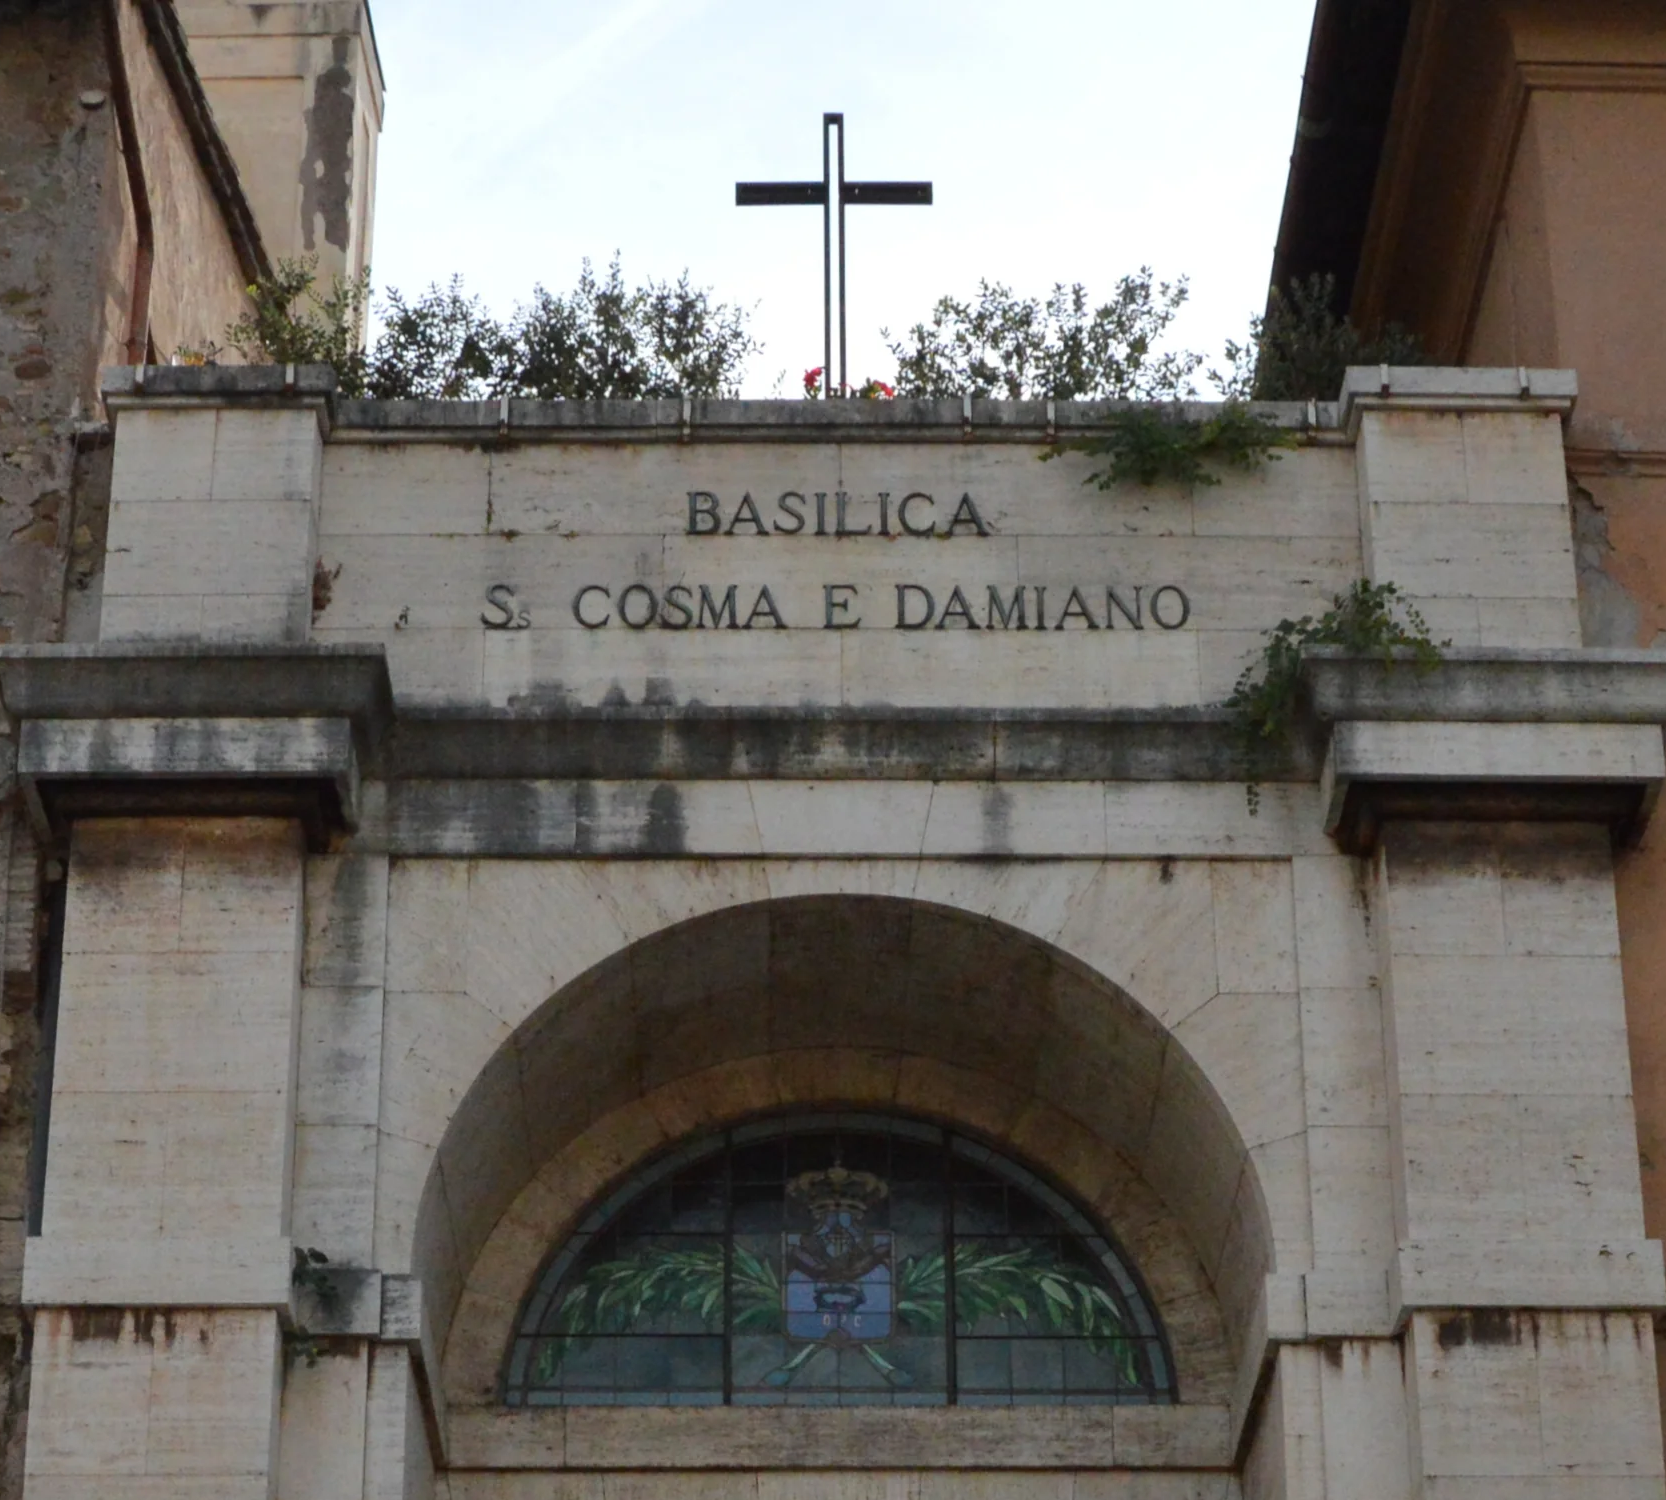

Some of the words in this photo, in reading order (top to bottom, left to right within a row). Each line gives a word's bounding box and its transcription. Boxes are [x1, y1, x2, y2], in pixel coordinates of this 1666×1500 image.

[686, 491, 990, 536] BASILICA
[572, 584, 787, 630] COSMA
[822, 585, 862, 630] E
[894, 585, 1190, 630] DAMIANO
